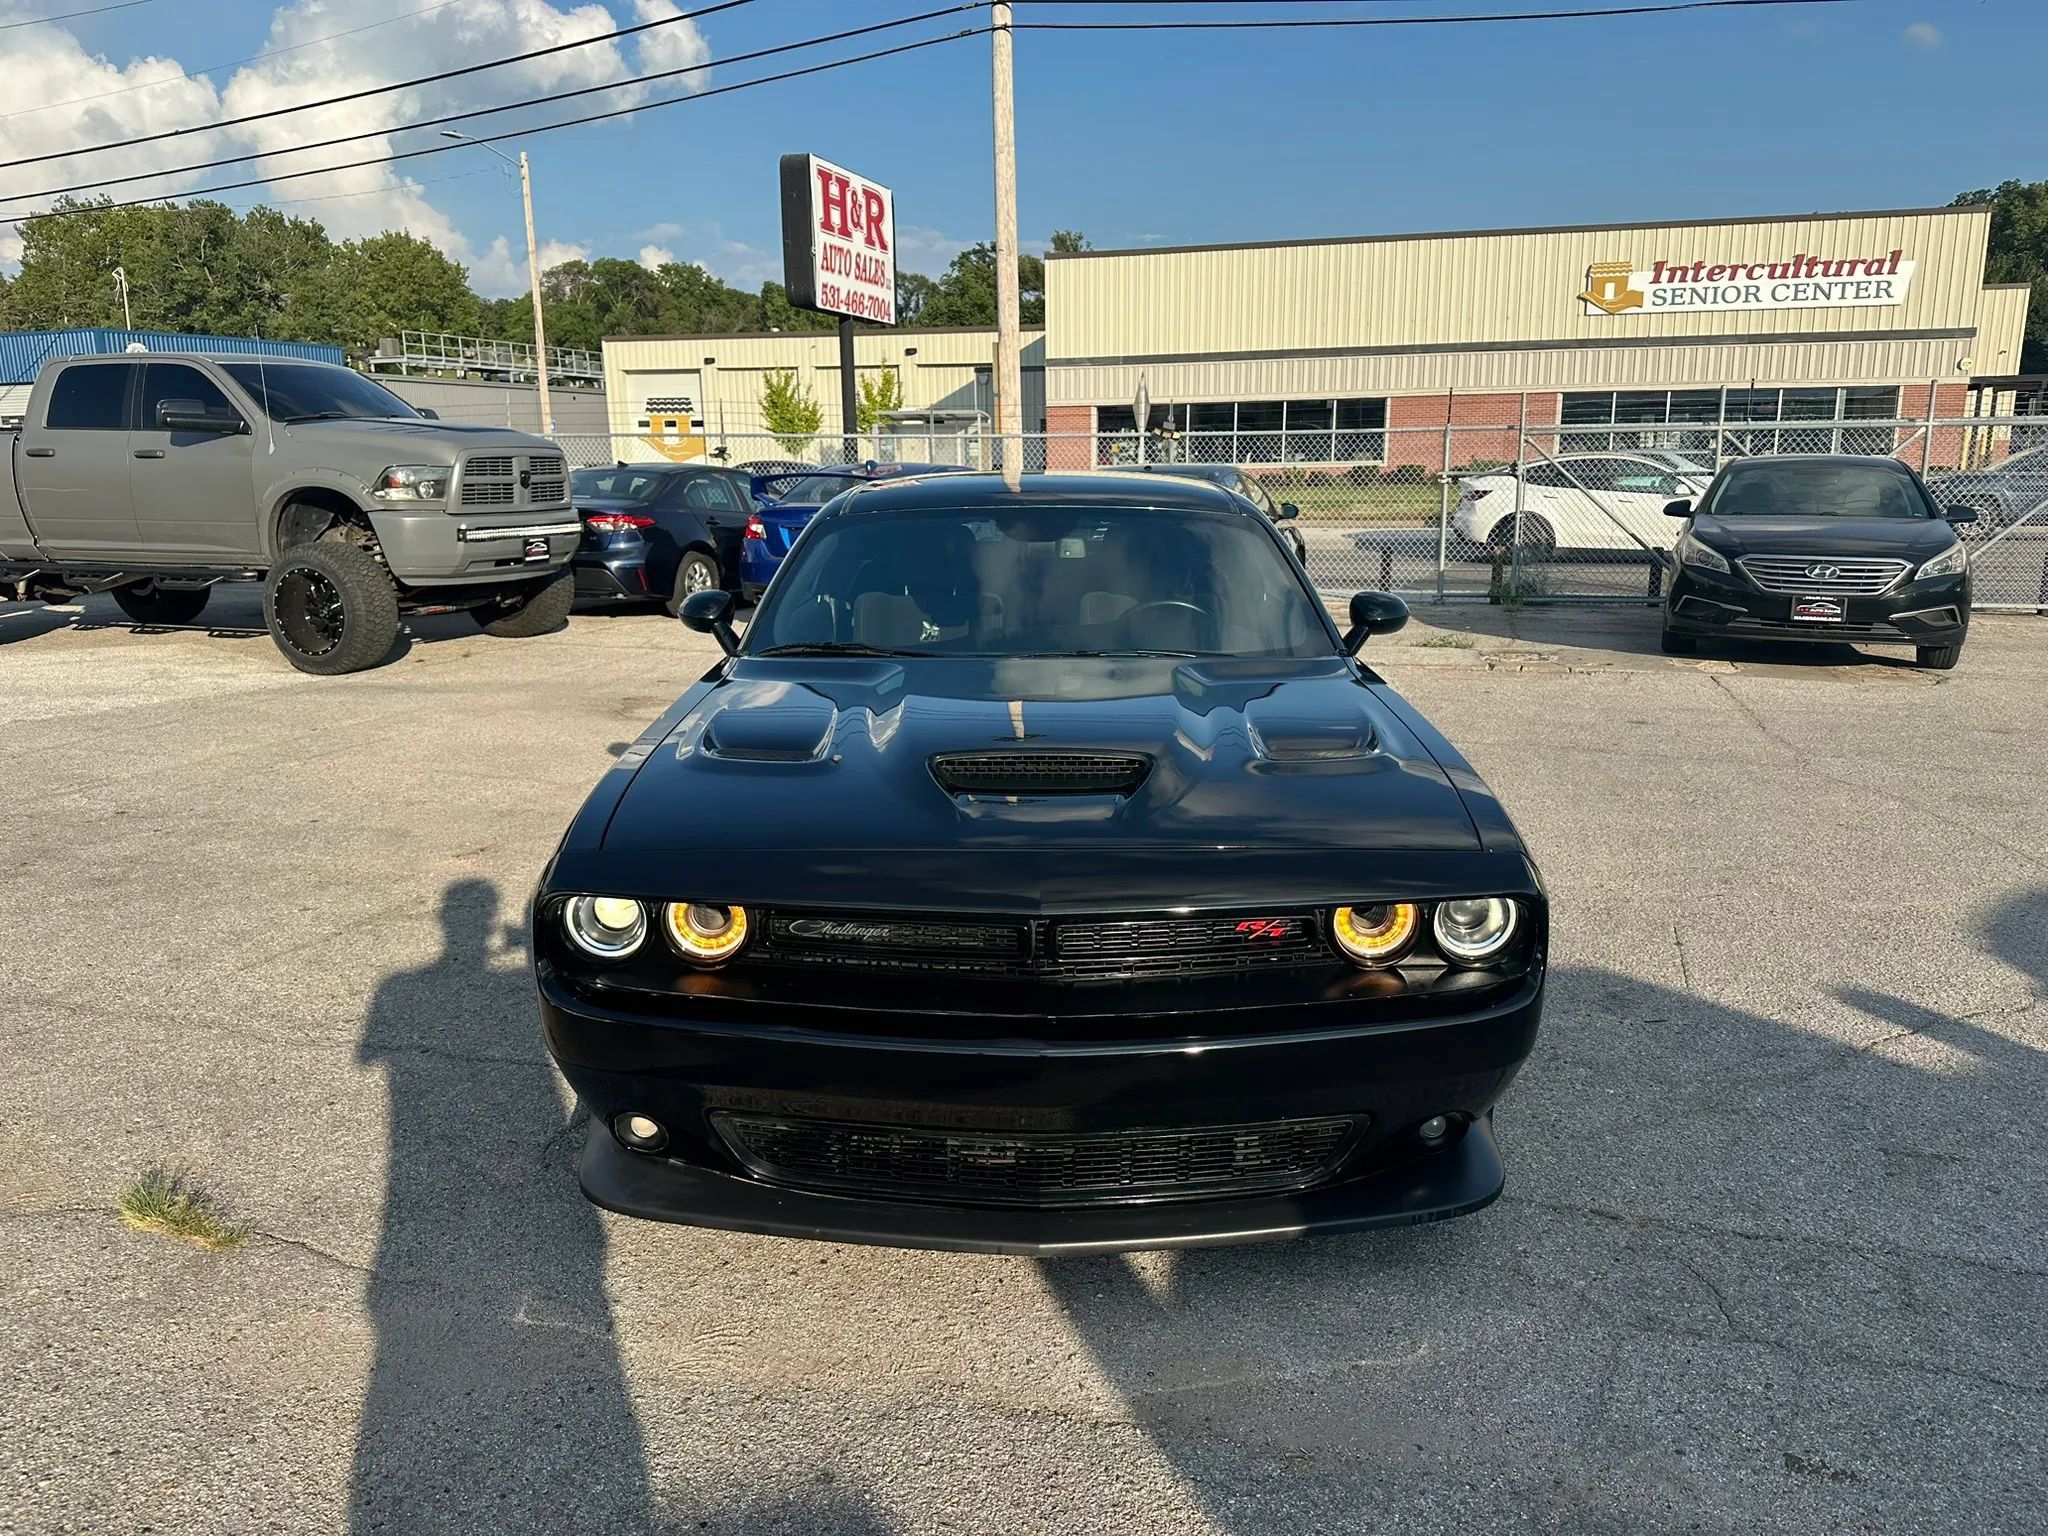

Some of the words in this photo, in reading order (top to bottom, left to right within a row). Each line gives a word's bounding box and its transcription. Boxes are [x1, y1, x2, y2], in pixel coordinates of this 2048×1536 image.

[816, 165, 889, 253] H&R
[821, 242, 851, 277] AUTO
[854, 252, 886, 288] SALES
[1649, 249, 1903, 285] Intercultural
[821, 283, 892, 322] 531-466-7004
[1651, 284, 1762, 307] SENIOR
[1771, 280, 1894, 302] CENTER
[789, 919, 890, 940] Challenger
[1235, 919, 1285, 940] R/T
